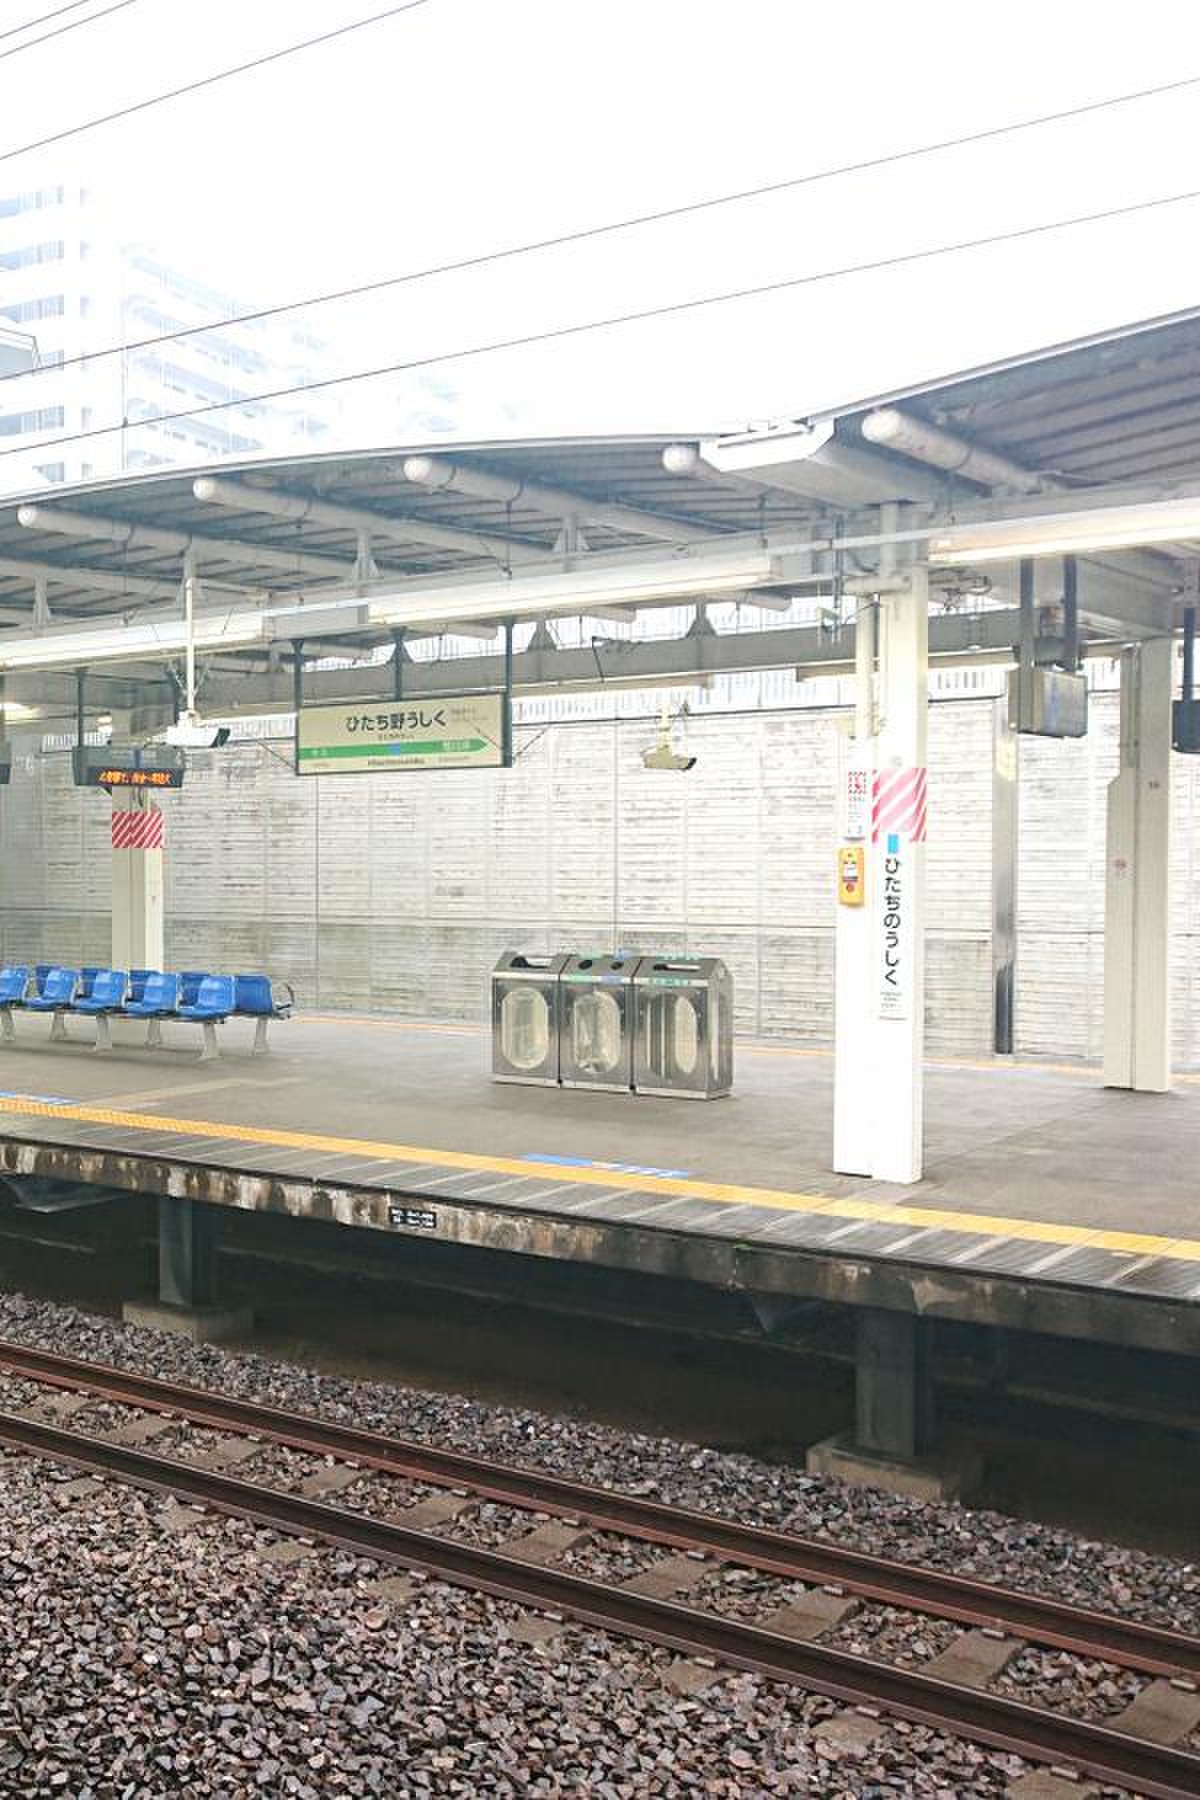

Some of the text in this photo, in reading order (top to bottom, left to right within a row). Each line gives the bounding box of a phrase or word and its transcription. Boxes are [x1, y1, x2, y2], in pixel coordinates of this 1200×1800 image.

[345, 709, 447, 732] ひたち野うしく
[883, 858, 902, 985] ひたちのうしく
